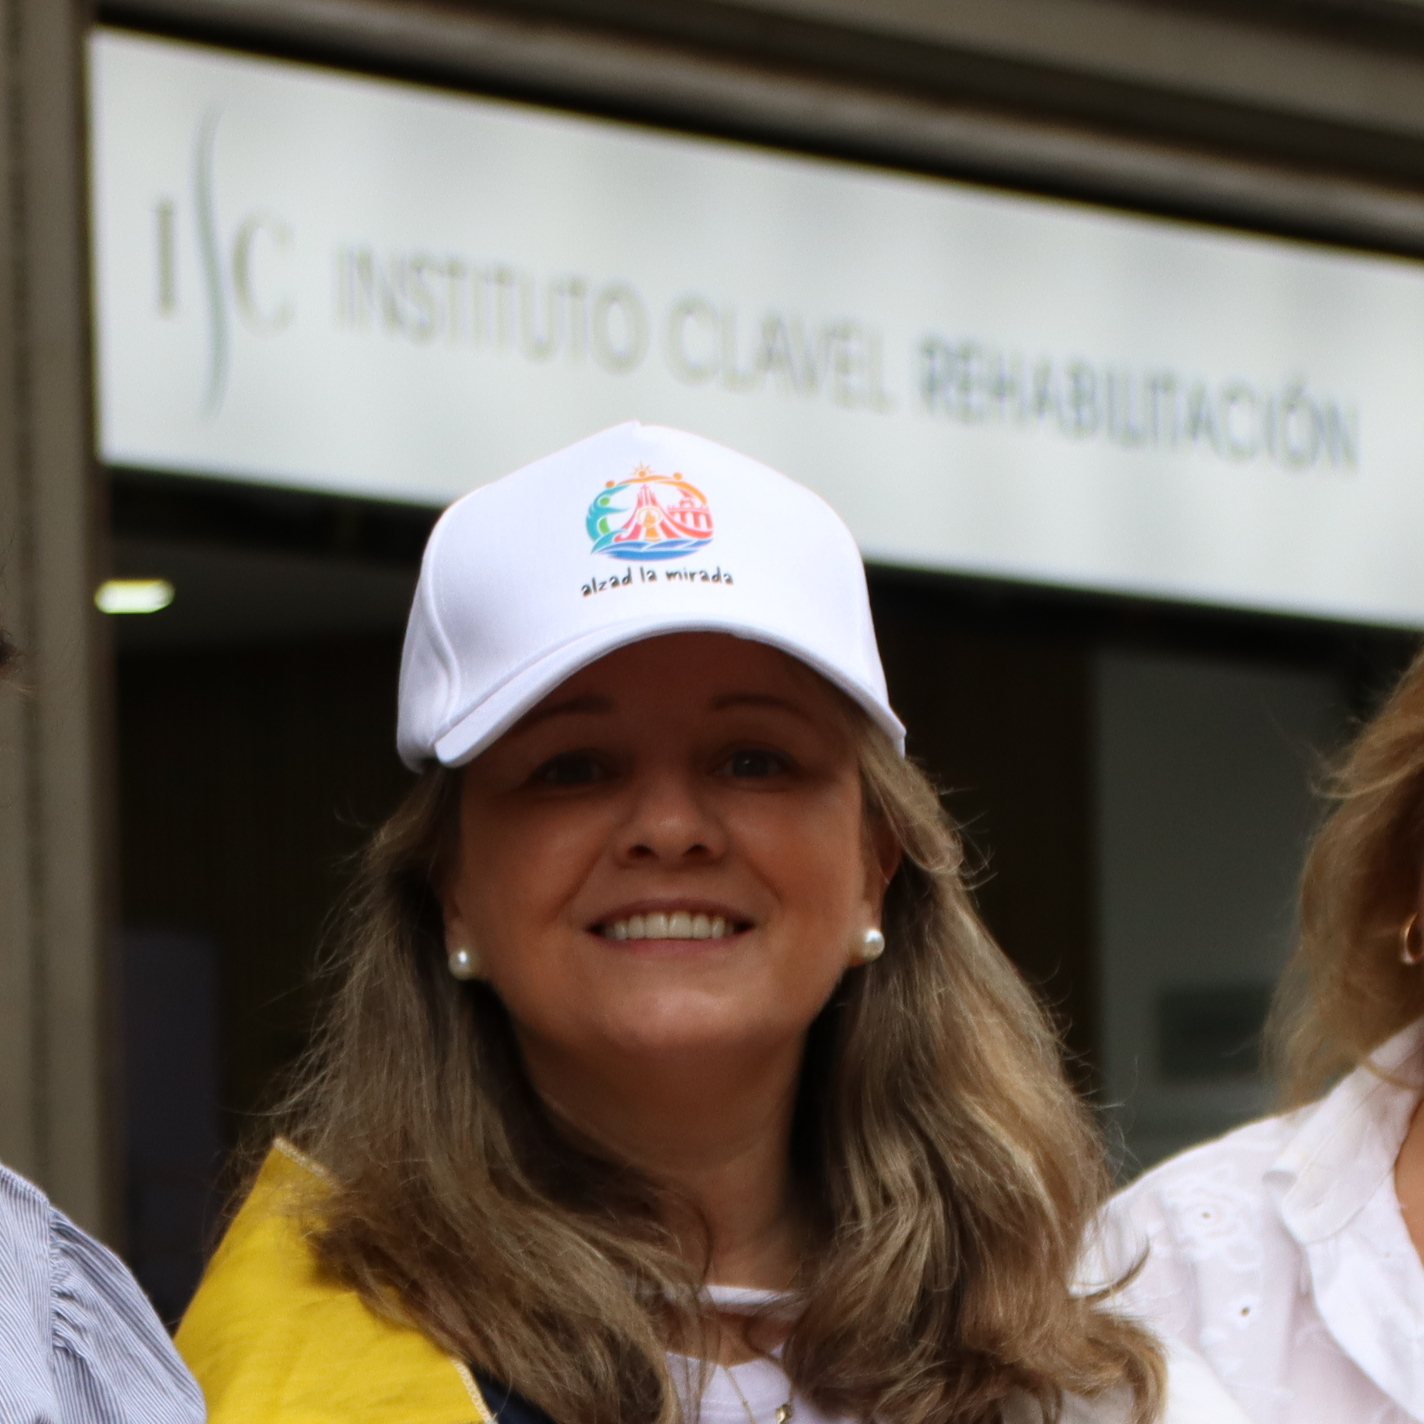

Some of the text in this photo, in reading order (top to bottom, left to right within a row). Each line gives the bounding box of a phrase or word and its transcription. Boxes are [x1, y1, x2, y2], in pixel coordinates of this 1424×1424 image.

[333, 243, 1363, 474] INSTITUTO CLAVEL REHABILITACIÓN
[581, 566, 734, 597] alzad la mirada
